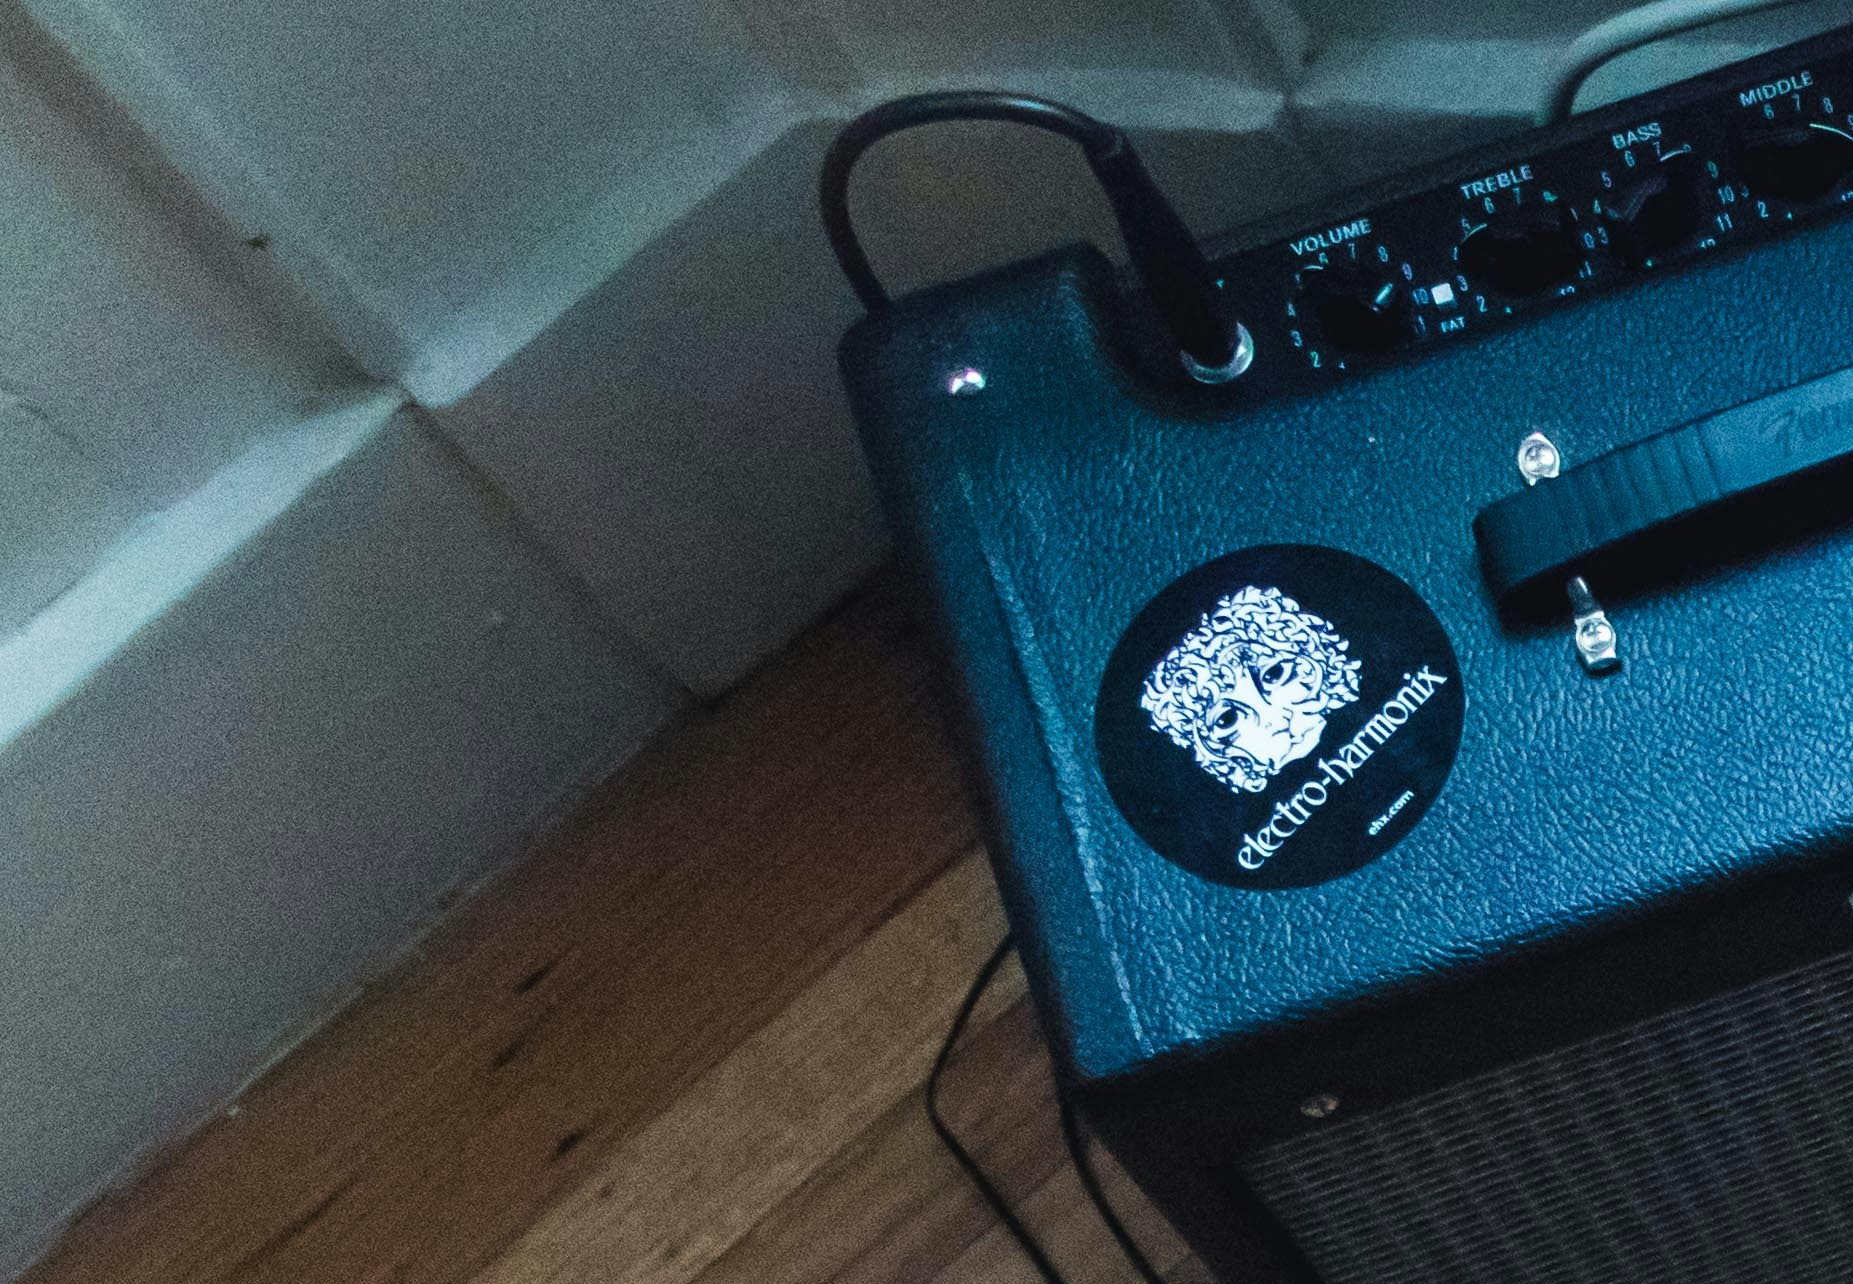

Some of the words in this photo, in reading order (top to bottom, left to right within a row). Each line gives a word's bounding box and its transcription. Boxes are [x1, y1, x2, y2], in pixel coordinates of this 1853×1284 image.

[1739, 69, 1814, 107] MIDDLE
[1612, 122, 1662, 149] BASS
[1460, 164, 1534, 200] TREBLE
[1289, 217, 1372, 256] VOLUME
[1476, 295, 1487, 313] 2
[1310, 350, 1322, 368] 2
[1238, 665, 1448, 870] electro-harmonix
[1367, 789, 1415, 836] ehx.com
